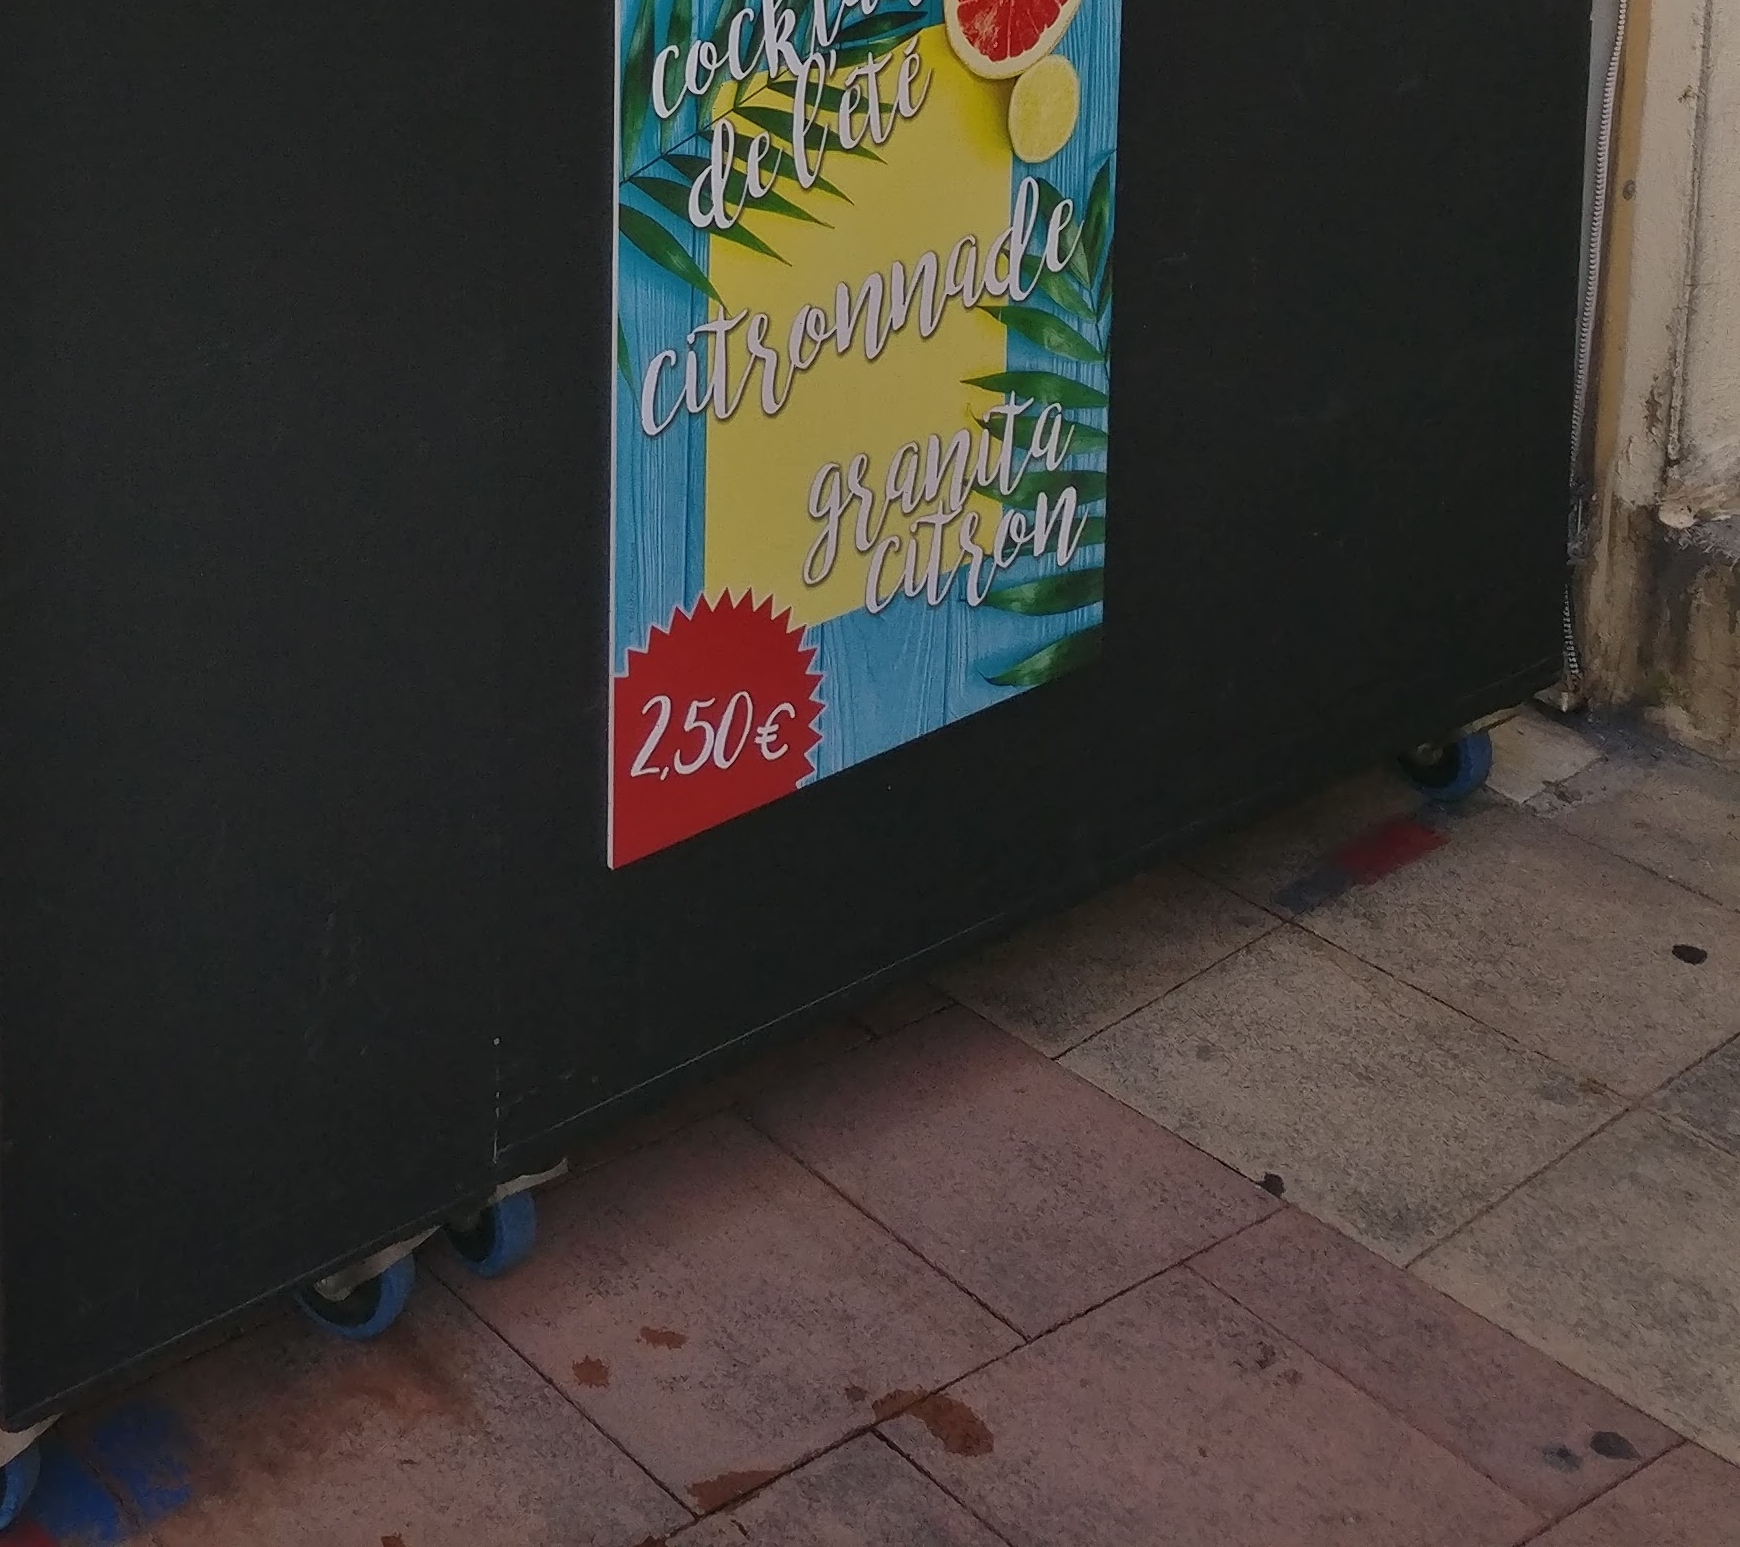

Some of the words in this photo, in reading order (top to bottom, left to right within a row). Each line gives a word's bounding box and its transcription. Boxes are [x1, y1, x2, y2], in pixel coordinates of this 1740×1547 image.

[688, 118, 784, 230] de
[791, 36, 935, 190] l'été
[640, 175, 1086, 437] citronnade
[801, 390, 1075, 586] granita
[865, 484, 1089, 615] citron
